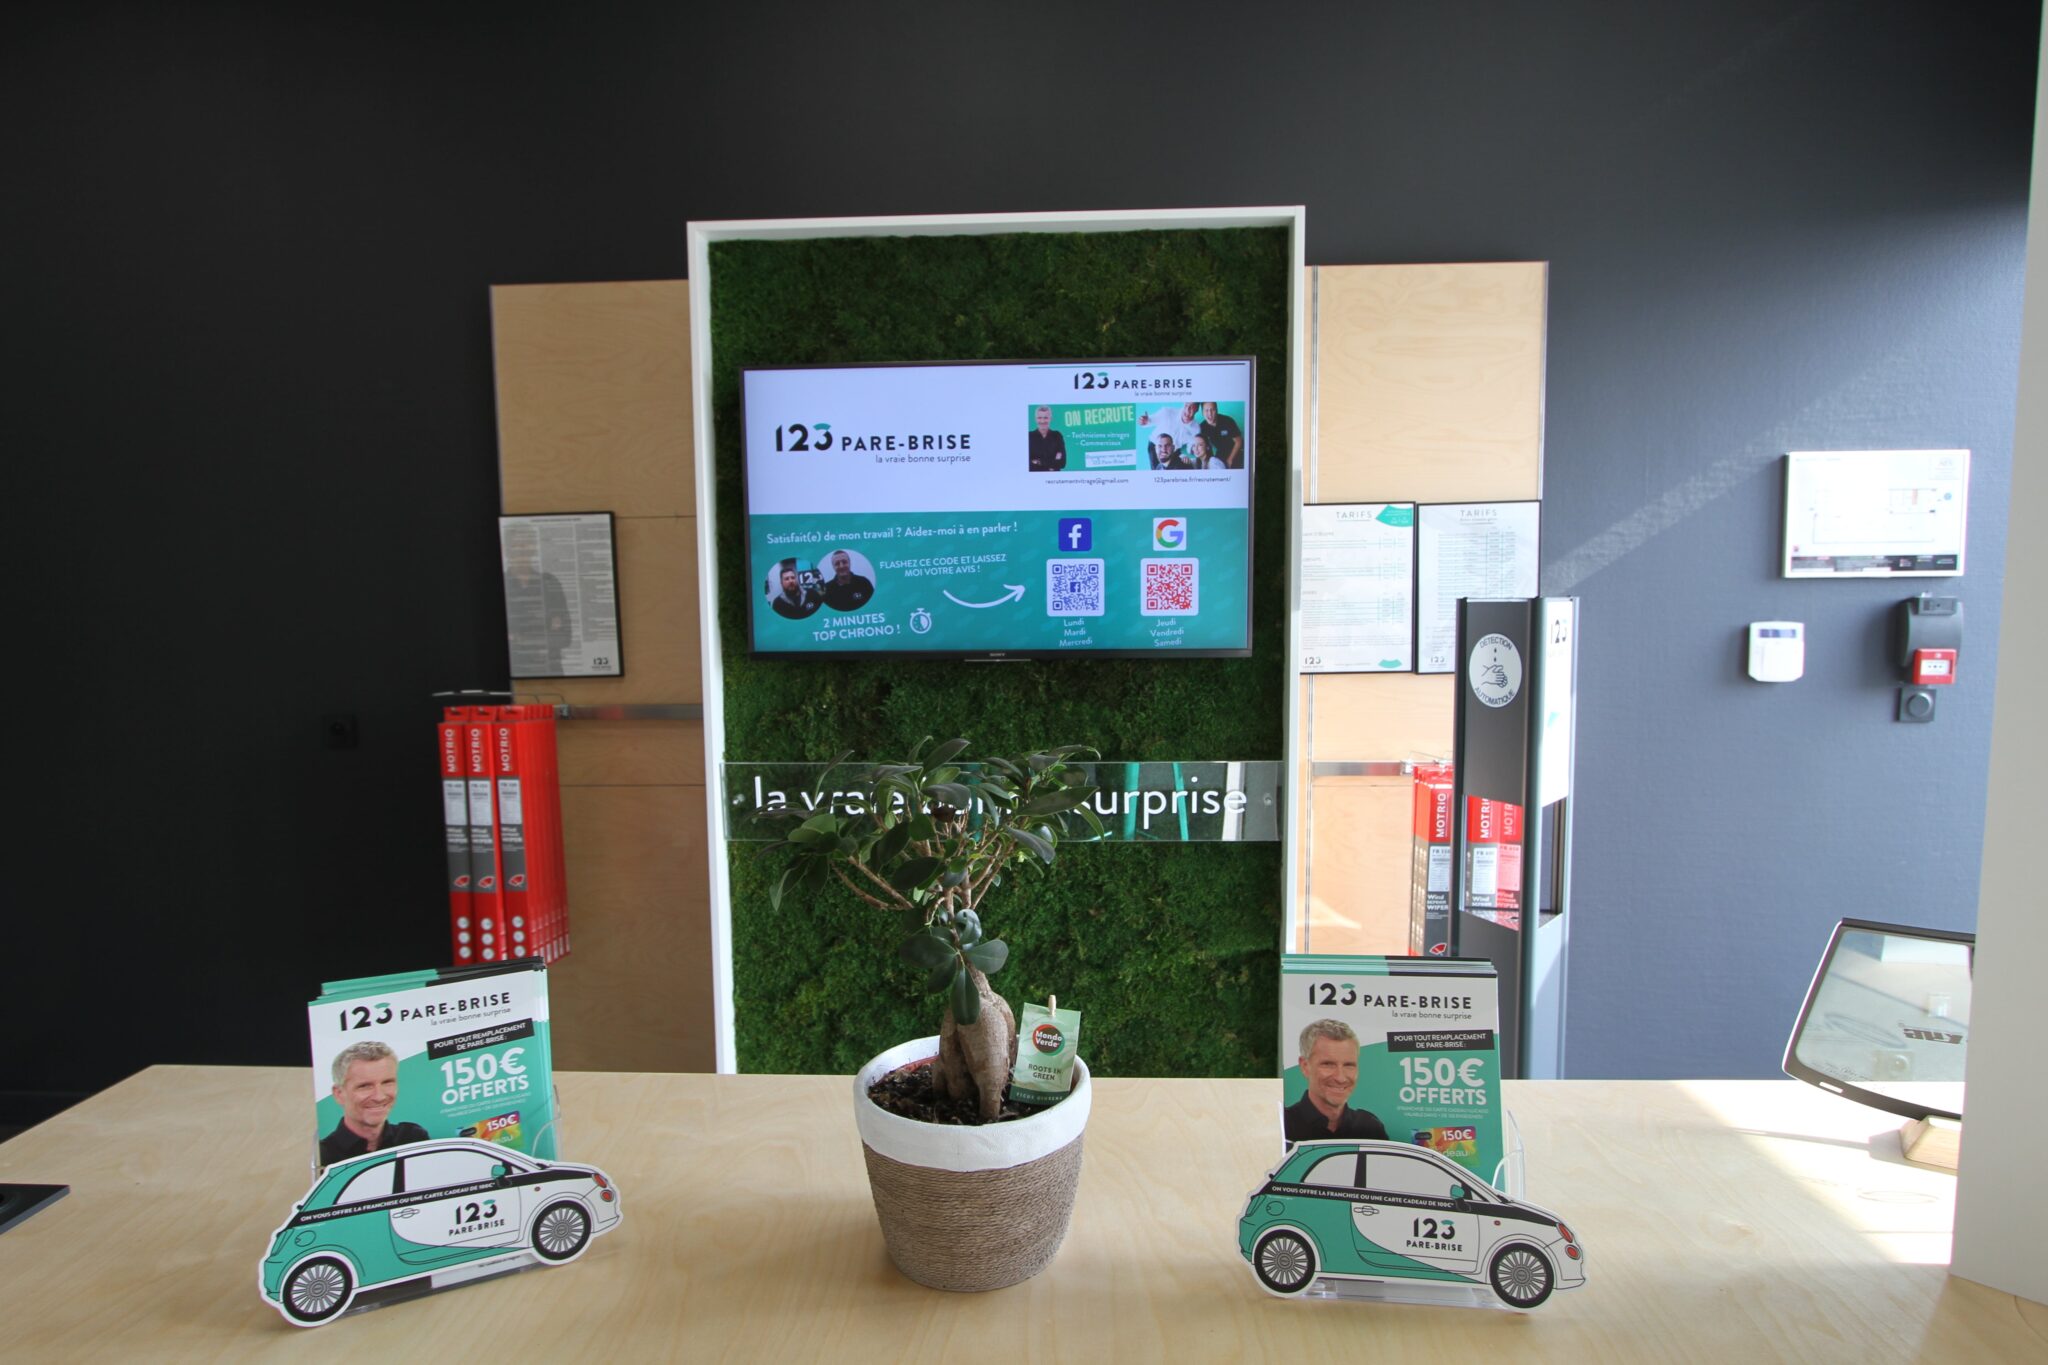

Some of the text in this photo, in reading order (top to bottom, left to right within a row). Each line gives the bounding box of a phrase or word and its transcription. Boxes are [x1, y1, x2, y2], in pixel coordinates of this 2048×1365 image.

[1074, 372, 1193, 390] 123 PARE-BRISE
[1064, 405, 1135, 427] ON RECRUTE
[775, 423, 971, 452] 123 PARE-BRISE
[1080, 439, 1121, 447] Commerciaux
[875, 453, 972, 465] la vraie bonne surprise
[1336, 510, 1373, 519] TARIFS
[1460, 509, 1498, 518] TARIFS
[766, 532, 822, 545] Satisfait(e)
[824, 531, 836, 542] de
[838, 531, 861, 541] mon
[863, 528, 895, 540] travail
[904, 525, 957, 538] Aidez-moi
[958, 523, 965, 535] à
[967, 525, 980, 535] en
[982, 523, 1012, 537] parler
[879, 553, 1007, 569] FLASHEZ CE CODE ET LAISSEZ
[904, 568, 923, 578] MOI
[925, 566, 954, 577] VOTRE
[955, 565, 975, 575] AVIS
[823, 613, 886, 628] 2 MINUTES
[1063, 619, 1085, 627] Lundi
[1156, 618, 1177, 627] Jeudi
[812, 629, 837, 642] TOP
[839, 626, 895, 640] CHRONO
[1064, 628, 1087, 636] Mardi
[1150, 627, 1185, 637] Vendredi
[1059, 637, 1093, 647] Mercredi
[1154, 637, 1182, 647] Samedi
[1479, 636, 1513, 651] DETECTION
[1474, 685, 1515, 706] AUTOMATIQUE
[444, 728, 457, 773] MOTRIO
[470, 728, 483, 773] MOTRIO
[499, 728, 511, 772] MOTRIO
[754, 776, 787, 814] la
[1435, 792, 1448, 839] MOTRIO
[1480, 798, 1492, 840] MOTRI
[1309, 983, 1472, 1010] 123 PARE-BRISE
[339, 992, 511, 1031] 123 PARE-BRISE
[430, 1007, 512, 1026] la vraie bonne surprise
[1392, 1010, 1472, 1021] la vraie bonne surprise
[434, 1022, 526, 1050] POUR TOUT REMPLACEMENT
[1035, 1030, 1063, 1042] Mondo
[1036, 1038, 1058, 1048] Verde
[1432, 1033, 1486, 1041] REMPLACEMENT
[457, 1043, 466, 1051] DE
[440, 1047, 527, 1088] 150€
[1028, 1063, 1052, 1074] ROOTS
[1032, 1072, 1056, 1081] GREEN
[1400, 1056, 1485, 1087] 150€
[441, 1074, 529, 1105] OFFERTS
[1400, 1086, 1487, 1105] OFFERTS
[486, 1113, 518, 1132] 150€
[1442, 1128, 1473, 1141] 150€
[301, 1214, 312, 1222] ON
[313, 1211, 331, 1220] VOUS
[331, 1207, 353, 1217] OFFRE
[362, 1199, 399, 1211] FRANCHISE
[410, 1195, 423, 1203] UNE
[424, 1192, 444, 1200] CARTE
[444, 1187, 469, 1197] CADEAU
[1283, 1186, 1298, 1194] VOUS
[1299, 1188, 1317, 1196] OFFRE
[1327, 1191, 1359, 1200] FRANCHISE
[1403, 1198, 1428, 1206] CADEAU
[456, 1199, 498, 1225] 123
[448, 1219, 505, 1237] PARE-BRISE
[1413, 1217, 1456, 1240] 123
[1406, 1240, 1463, 1252] PARE-BRISE
